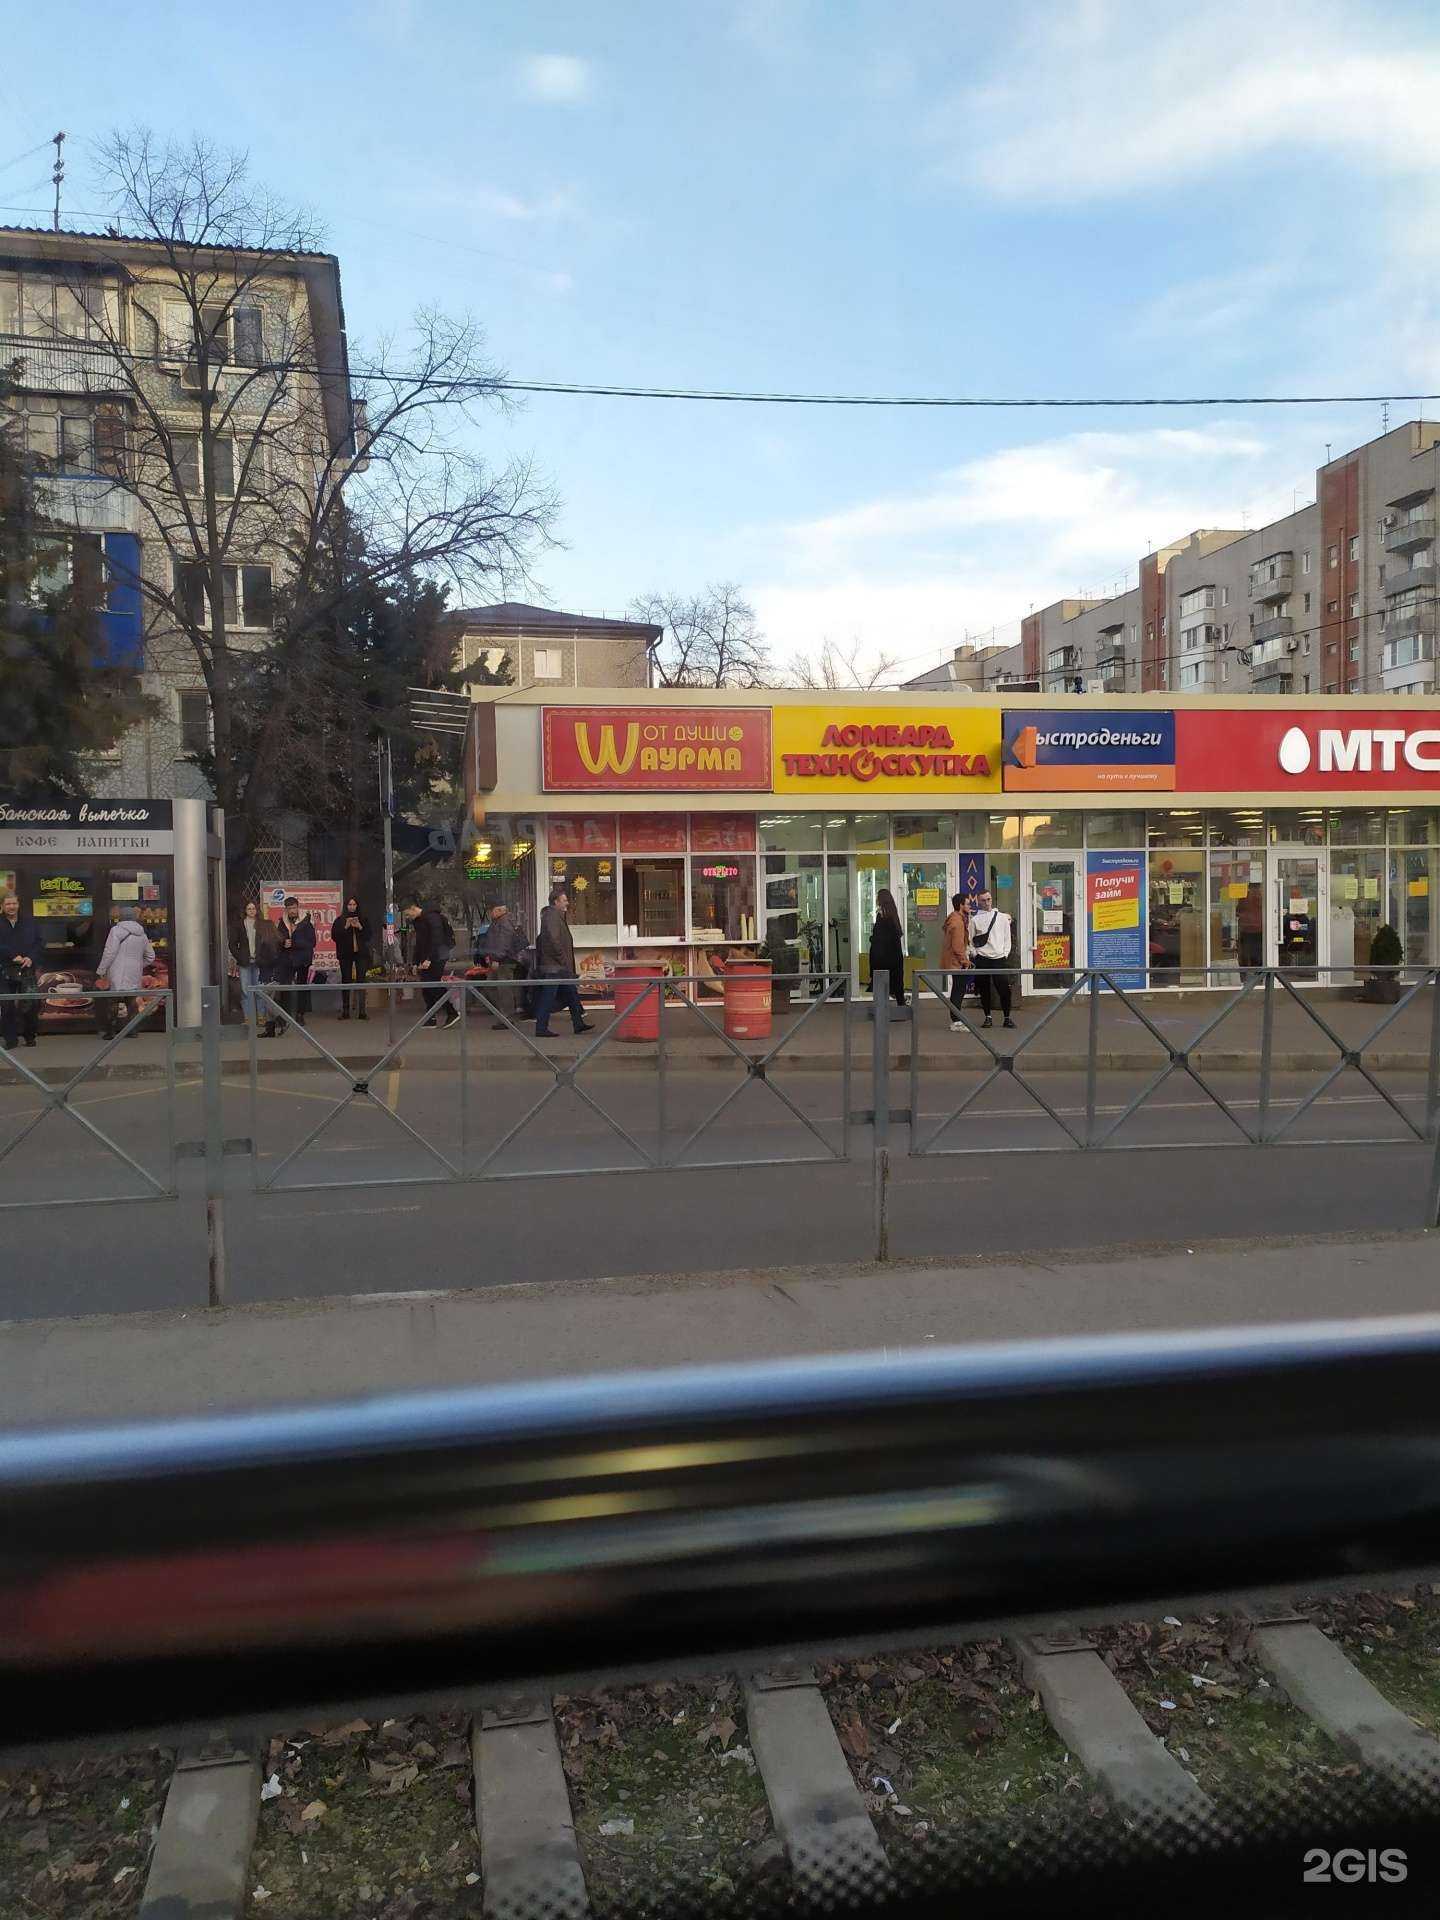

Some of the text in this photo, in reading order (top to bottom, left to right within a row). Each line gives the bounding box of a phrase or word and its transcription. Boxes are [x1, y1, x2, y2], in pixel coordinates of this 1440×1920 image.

[643, 725, 669, 741] ОТ
[821, 725, 955, 749] ЛОМБАРД
[1318, 729, 1440, 772] МТС
[782, 749, 993, 782] ТЕХНОСКУПКА
[78, 803, 150, 822] выпечка
[15, 836, 149, 848] КОФЕ НАПИТКИ
[1095, 876, 1135, 888] Получи
[1095, 888, 1122, 900] займ
